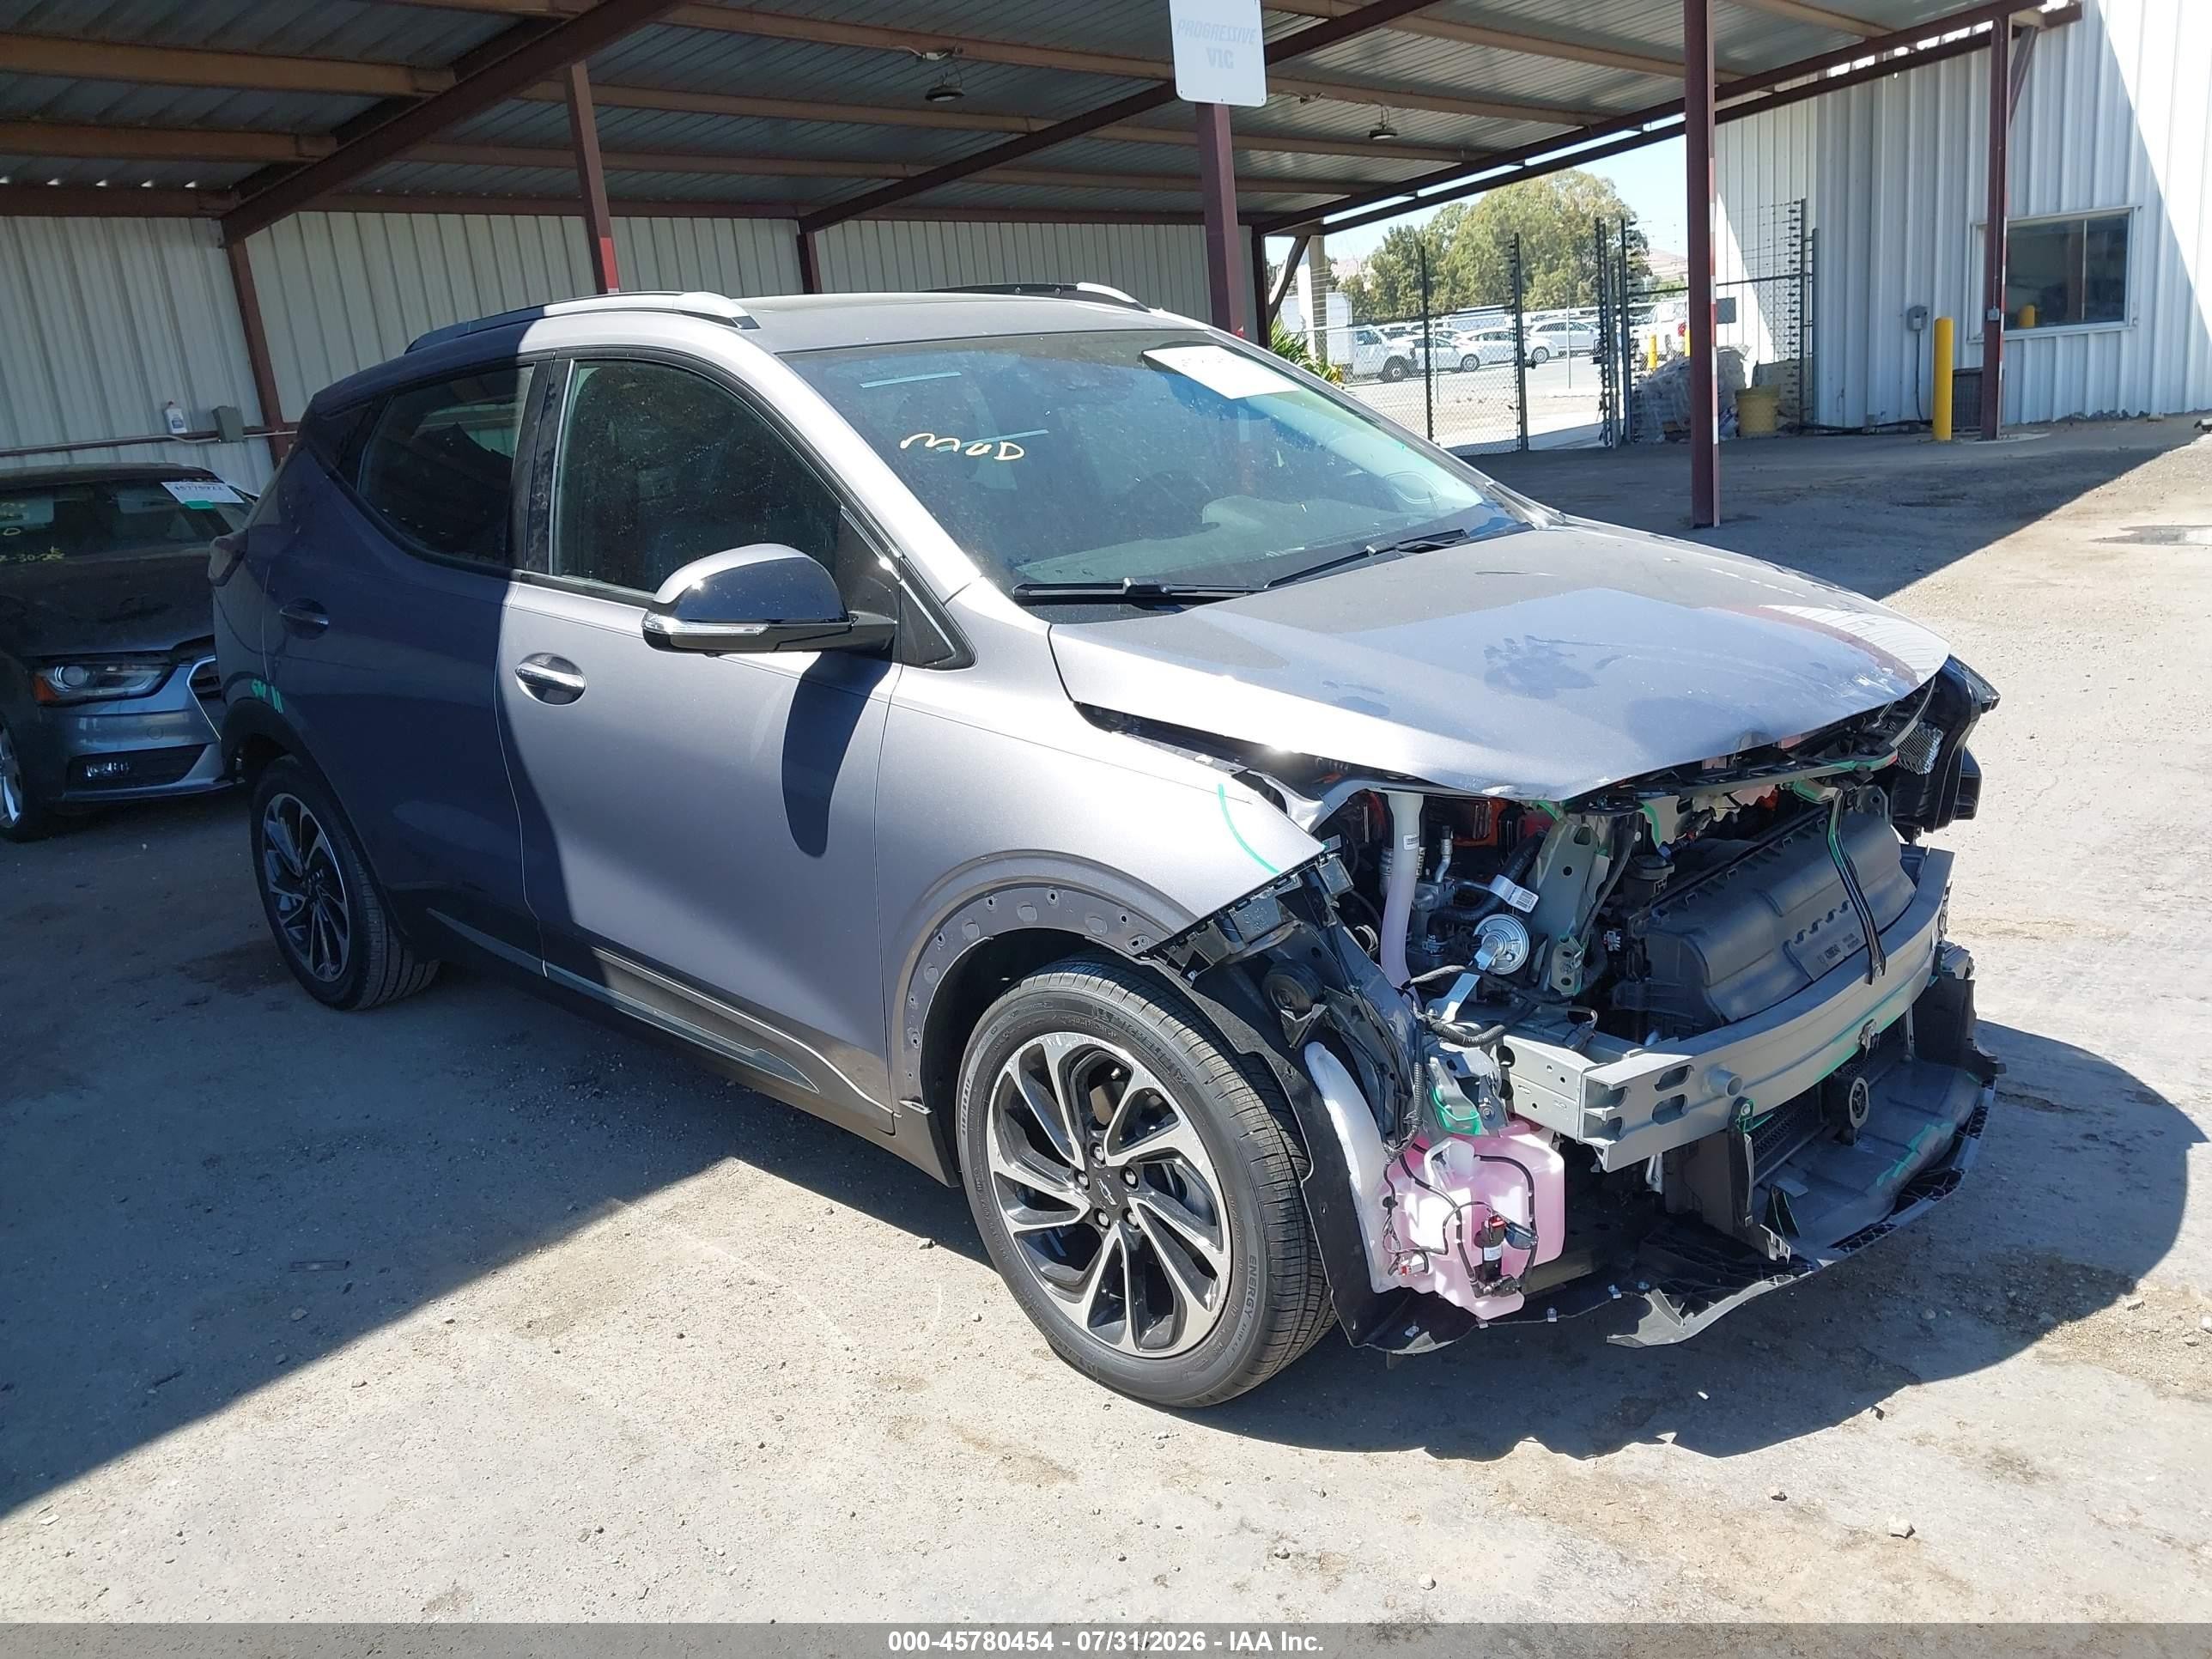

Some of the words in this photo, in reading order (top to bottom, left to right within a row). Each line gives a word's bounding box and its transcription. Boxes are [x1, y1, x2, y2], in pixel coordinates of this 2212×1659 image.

[1176, 19, 1257, 45] PROGRESSIVE
[1206, 46, 1234, 70] VIC
[1244, 1255, 1258, 1319] ENERGY
